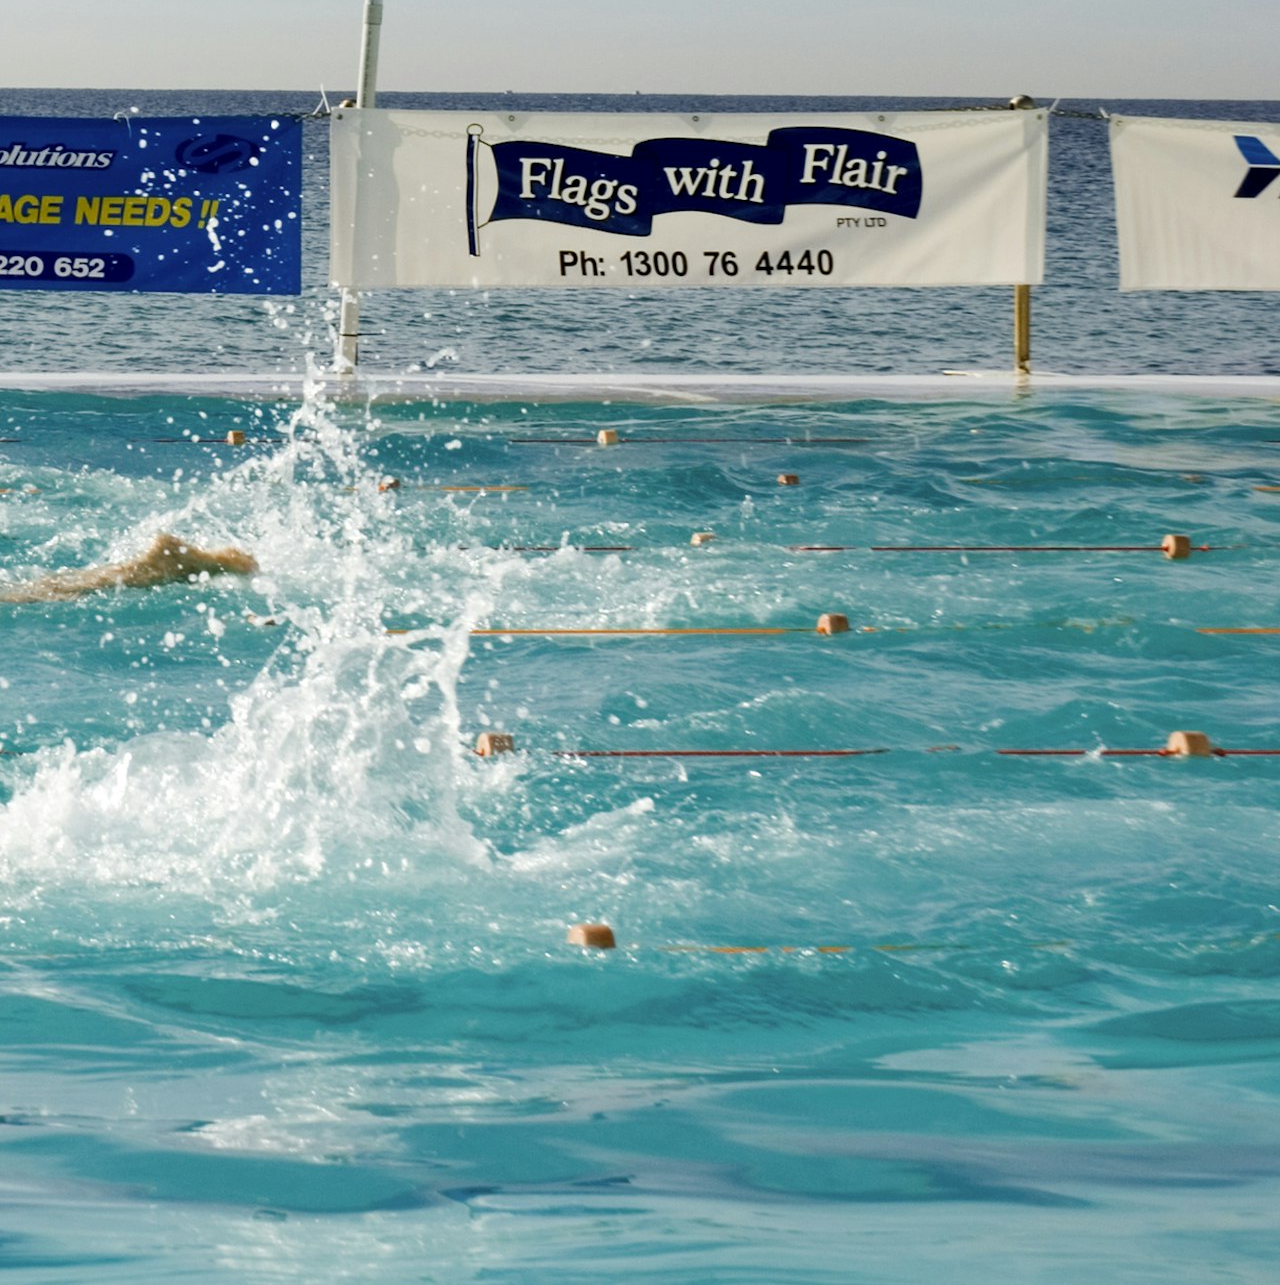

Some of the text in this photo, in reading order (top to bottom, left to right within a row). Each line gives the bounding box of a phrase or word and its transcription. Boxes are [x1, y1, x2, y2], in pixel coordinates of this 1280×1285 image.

[519, 143, 908, 221] Flags with Flair
[75, 196, 193, 228] NEEDS
[836, 217, 887, 227] PTY LTD
[54, 257, 105, 278] 652
[559, 249, 834, 277] Ph: 1300 76 4440
